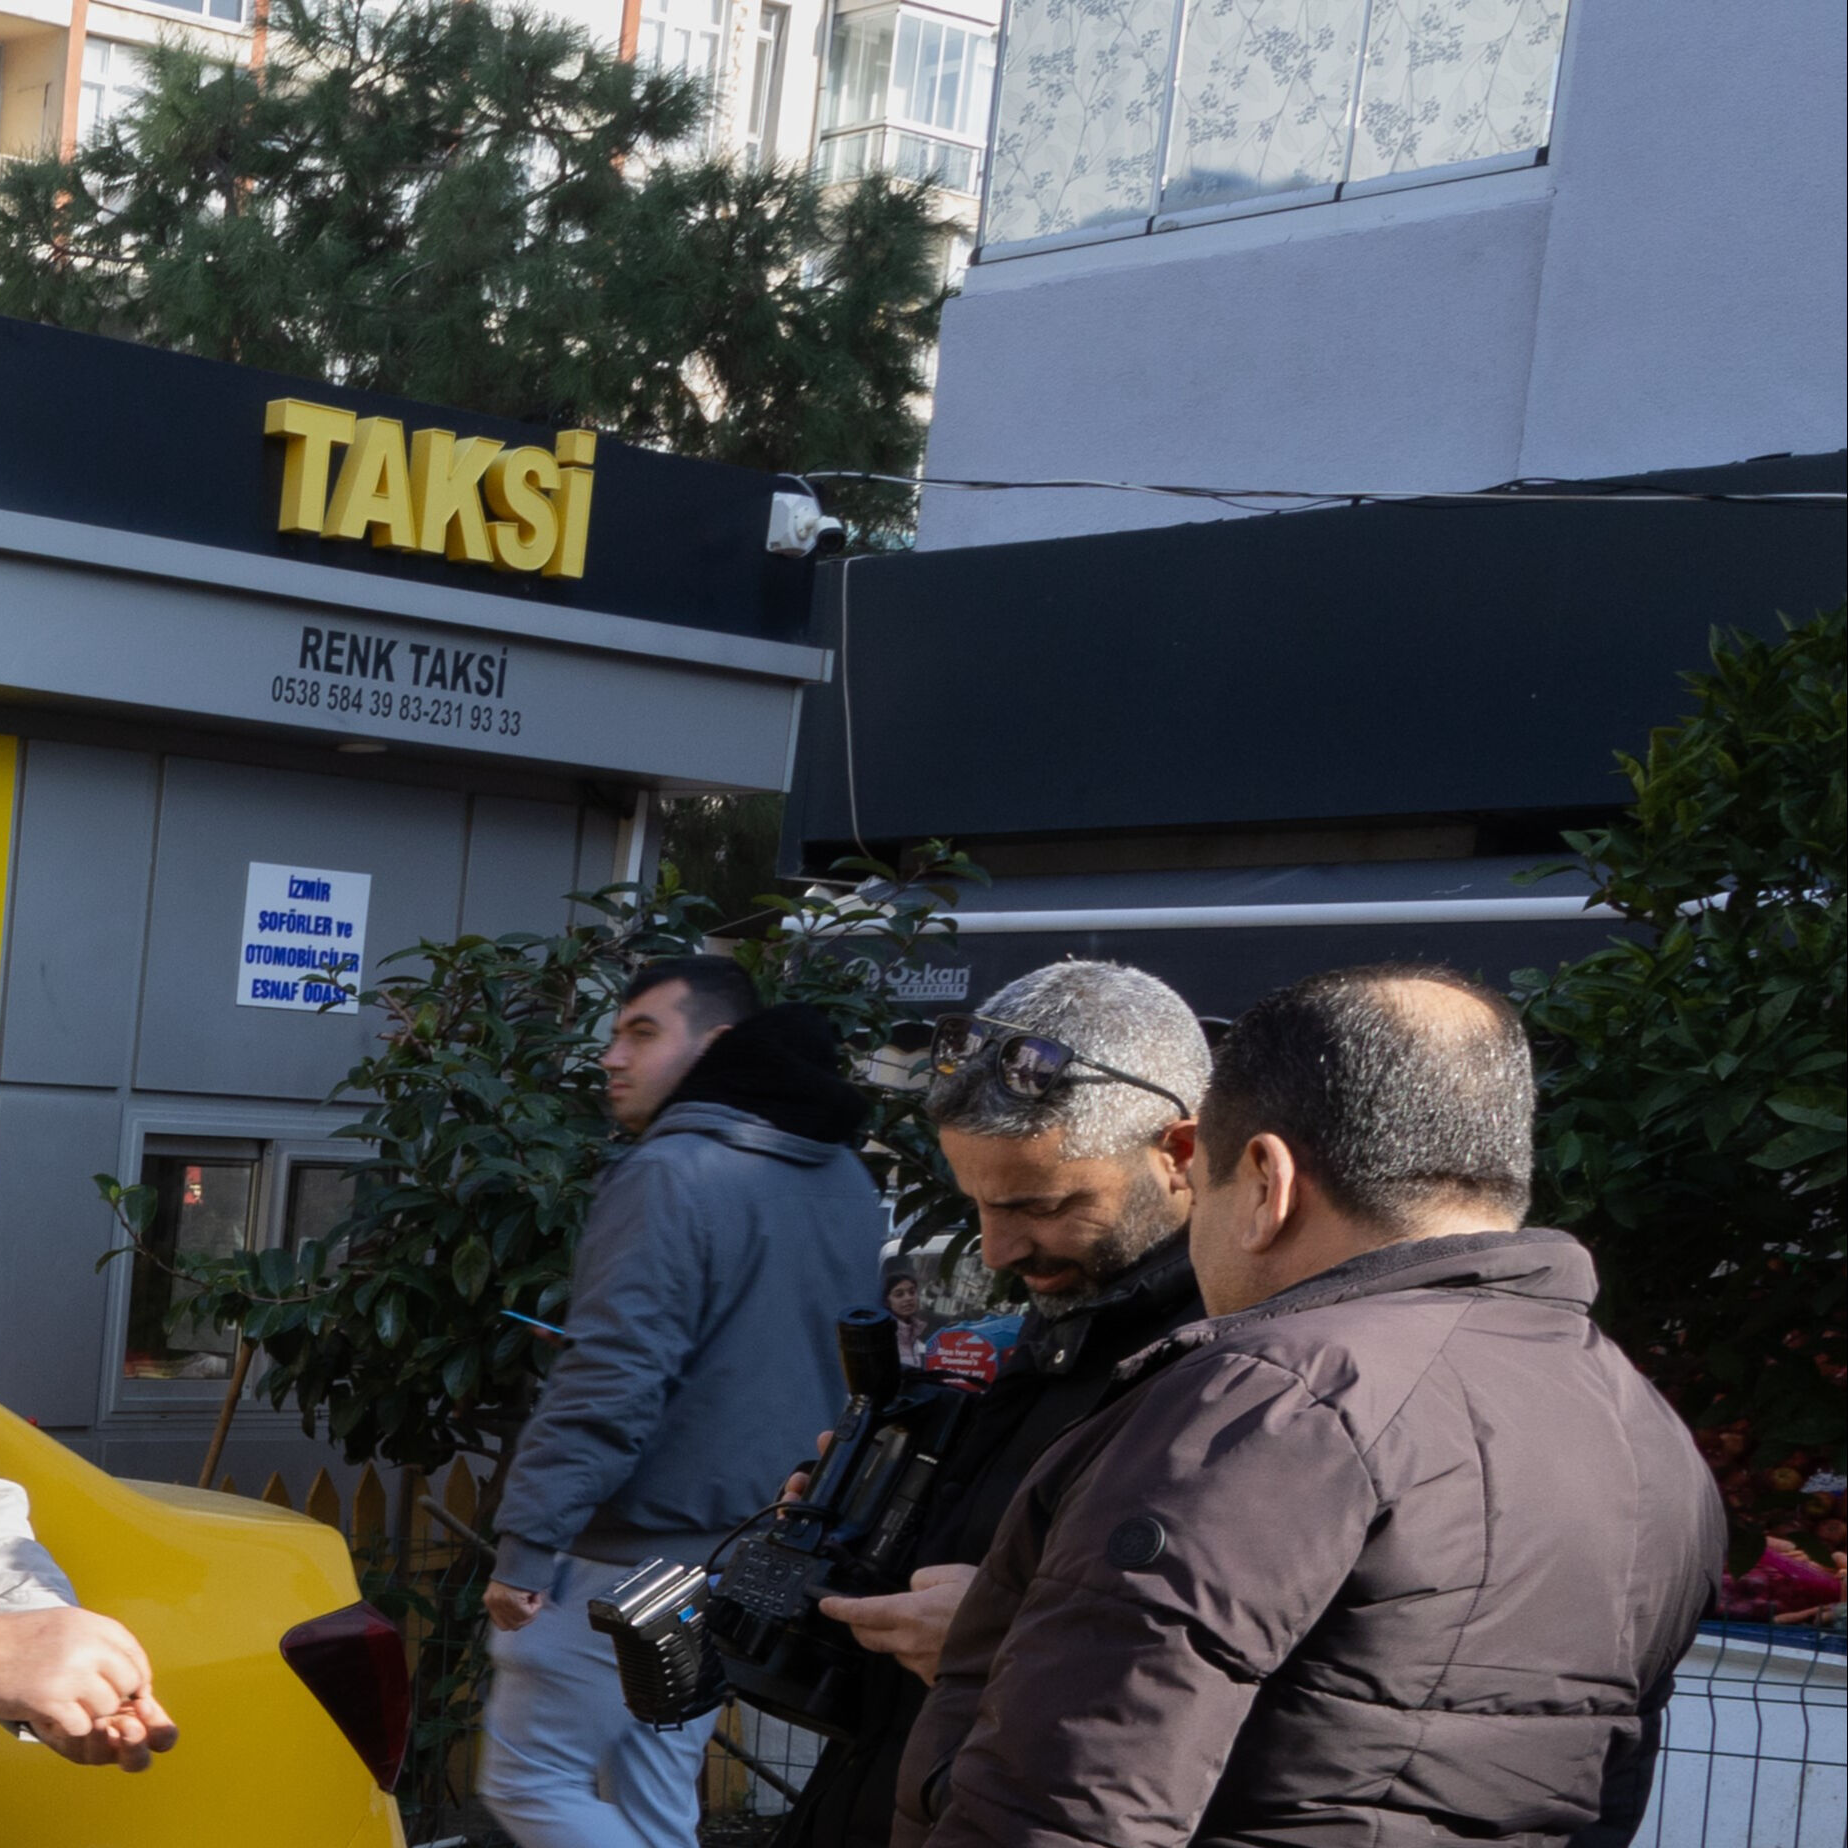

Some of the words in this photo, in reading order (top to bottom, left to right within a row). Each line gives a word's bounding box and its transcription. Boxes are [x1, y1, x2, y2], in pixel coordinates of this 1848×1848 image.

[263, 397, 597, 579] TAKSİ
[298, 626, 400, 682] RENK
[409, 647, 508, 699] TAKSİ
[271, 675, 321, 707] 0538
[327, 682, 364, 715] 584
[369, 690, 393, 719] 39
[399, 694, 463, 730] 83-231
[470, 708, 494, 733] 93
[498, 710, 522, 737] 33
[288, 875, 331, 902] İZMİR
[258, 909, 333, 936] ŞOFÖRLER
[336, 921, 353, 938] ve
[251, 978, 299, 1001] ESNAF
